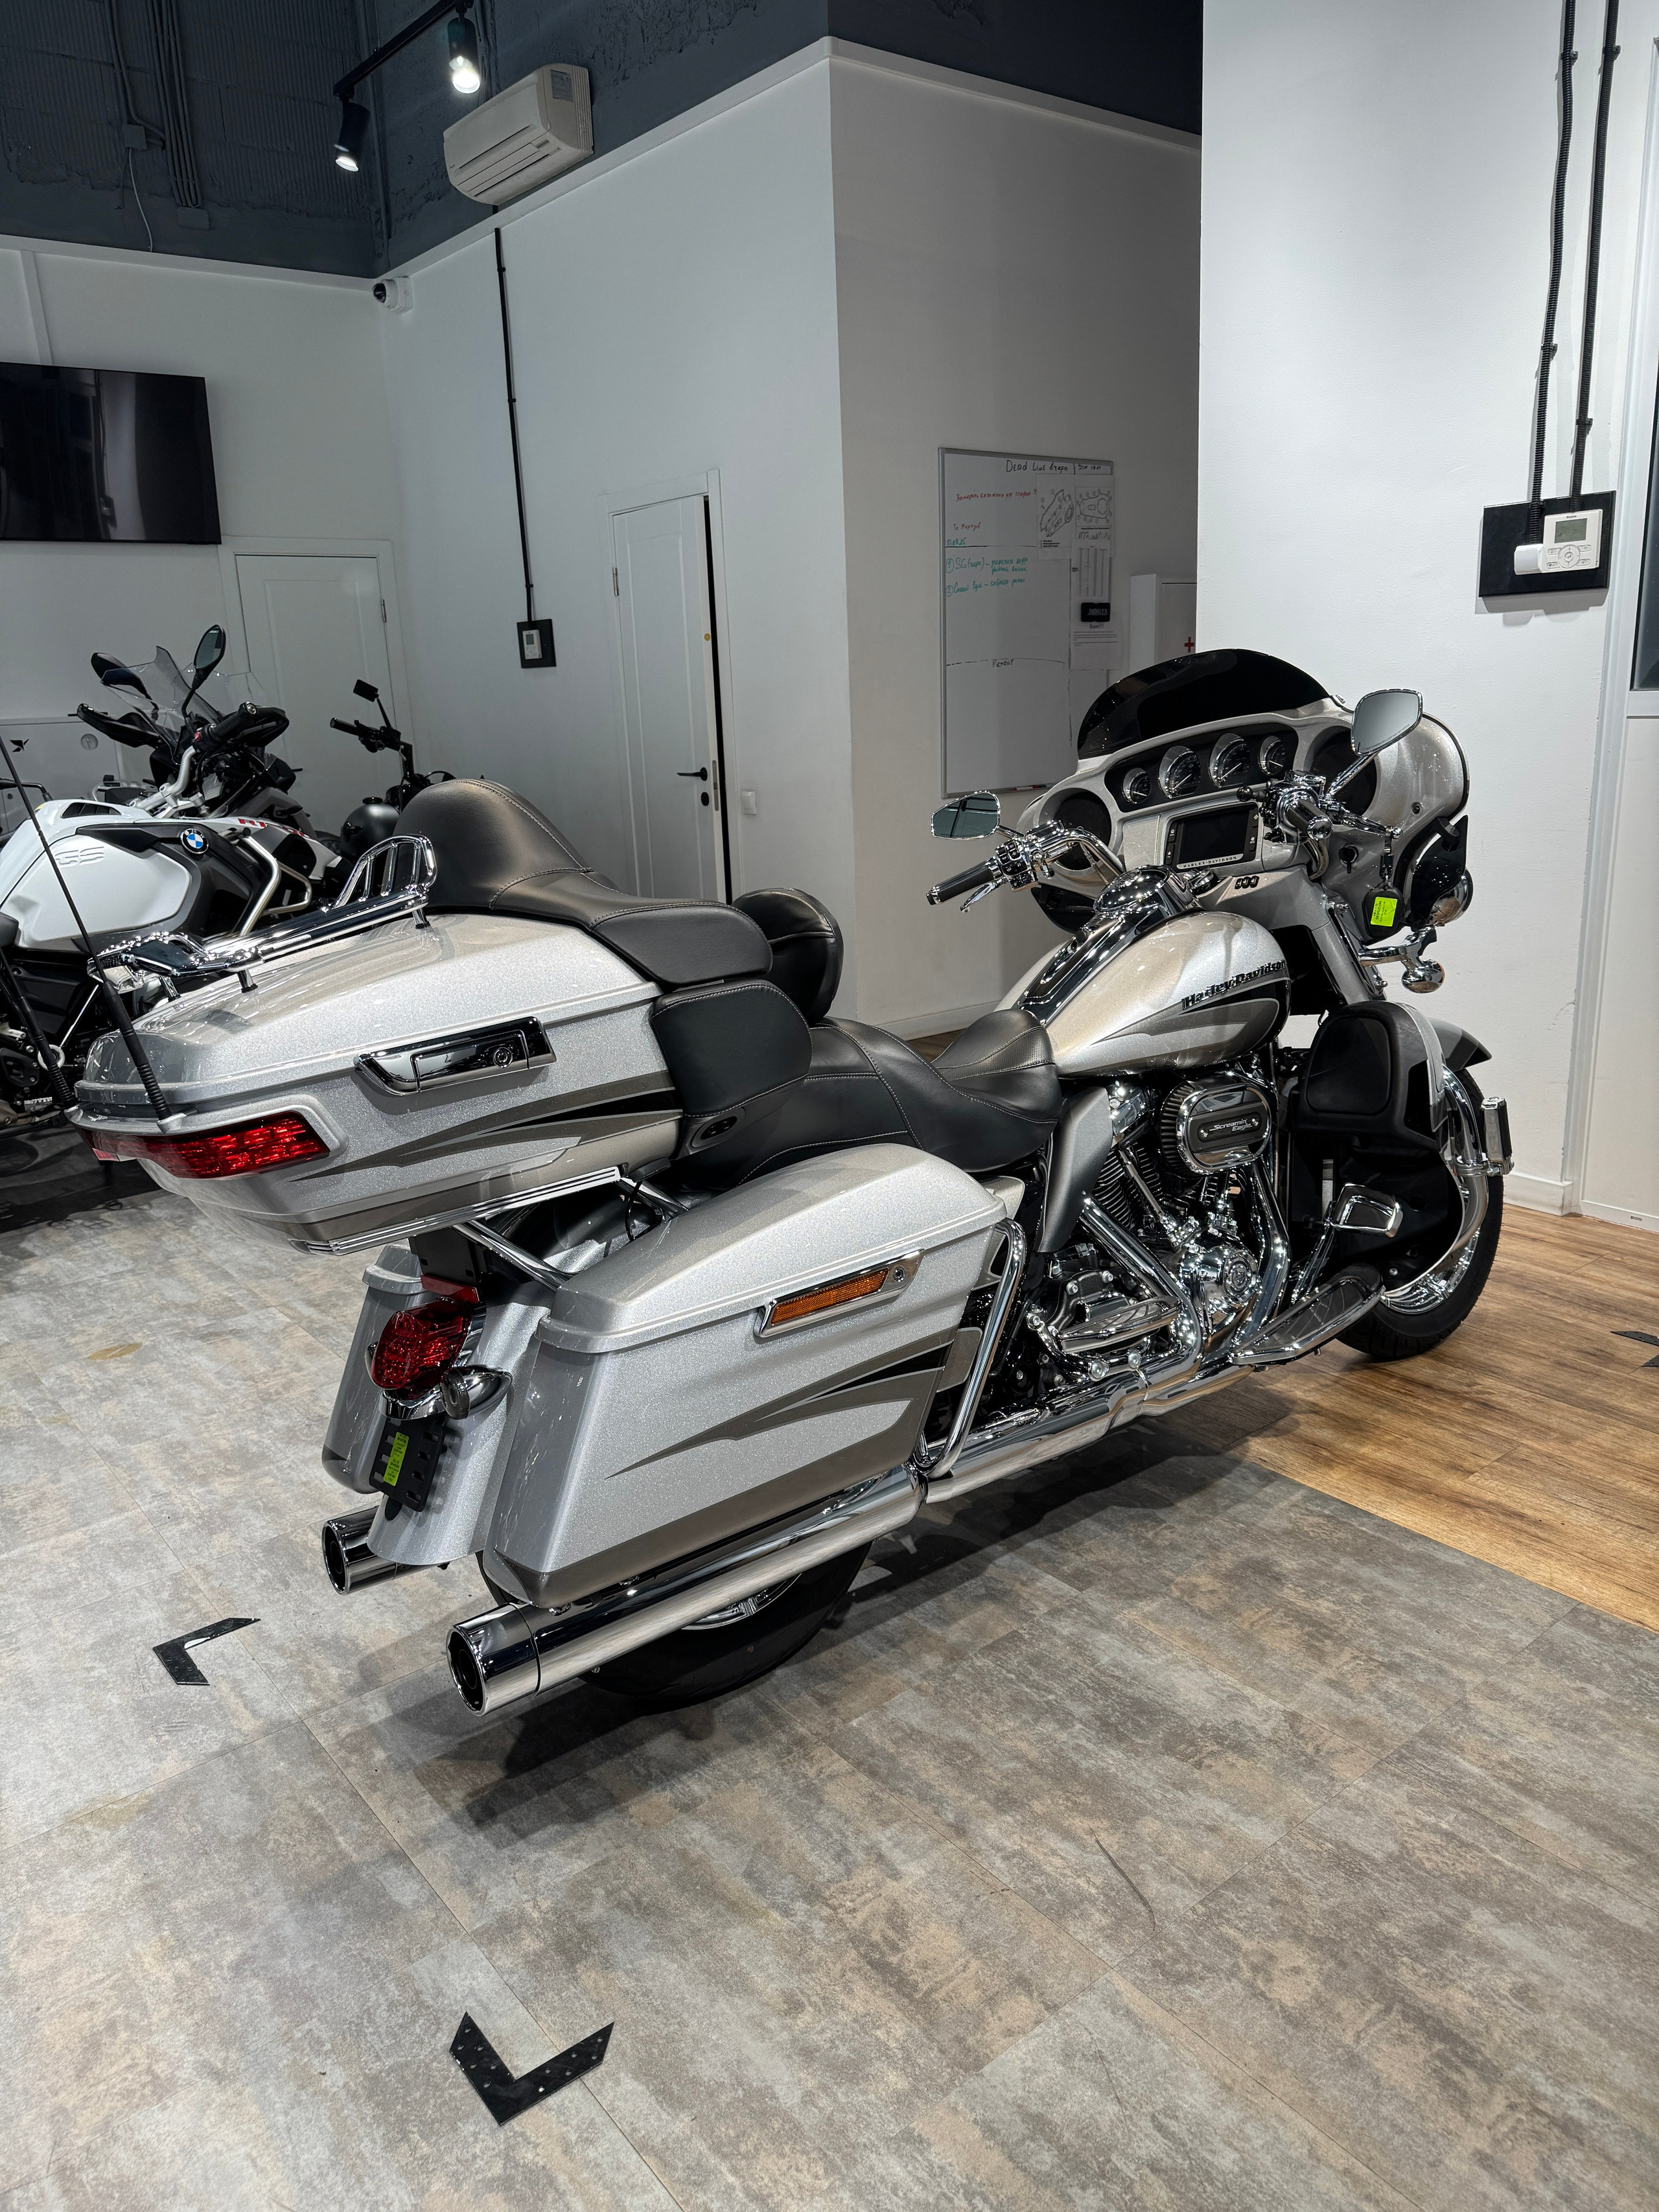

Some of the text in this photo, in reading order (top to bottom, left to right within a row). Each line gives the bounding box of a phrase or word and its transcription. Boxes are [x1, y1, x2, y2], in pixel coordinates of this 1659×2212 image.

[54, 846, 104, 868] GS
[1183, 856, 1238, 868] HARLEY-DAVIDSON
[1232, 1123, 1253, 1132] Eagle
